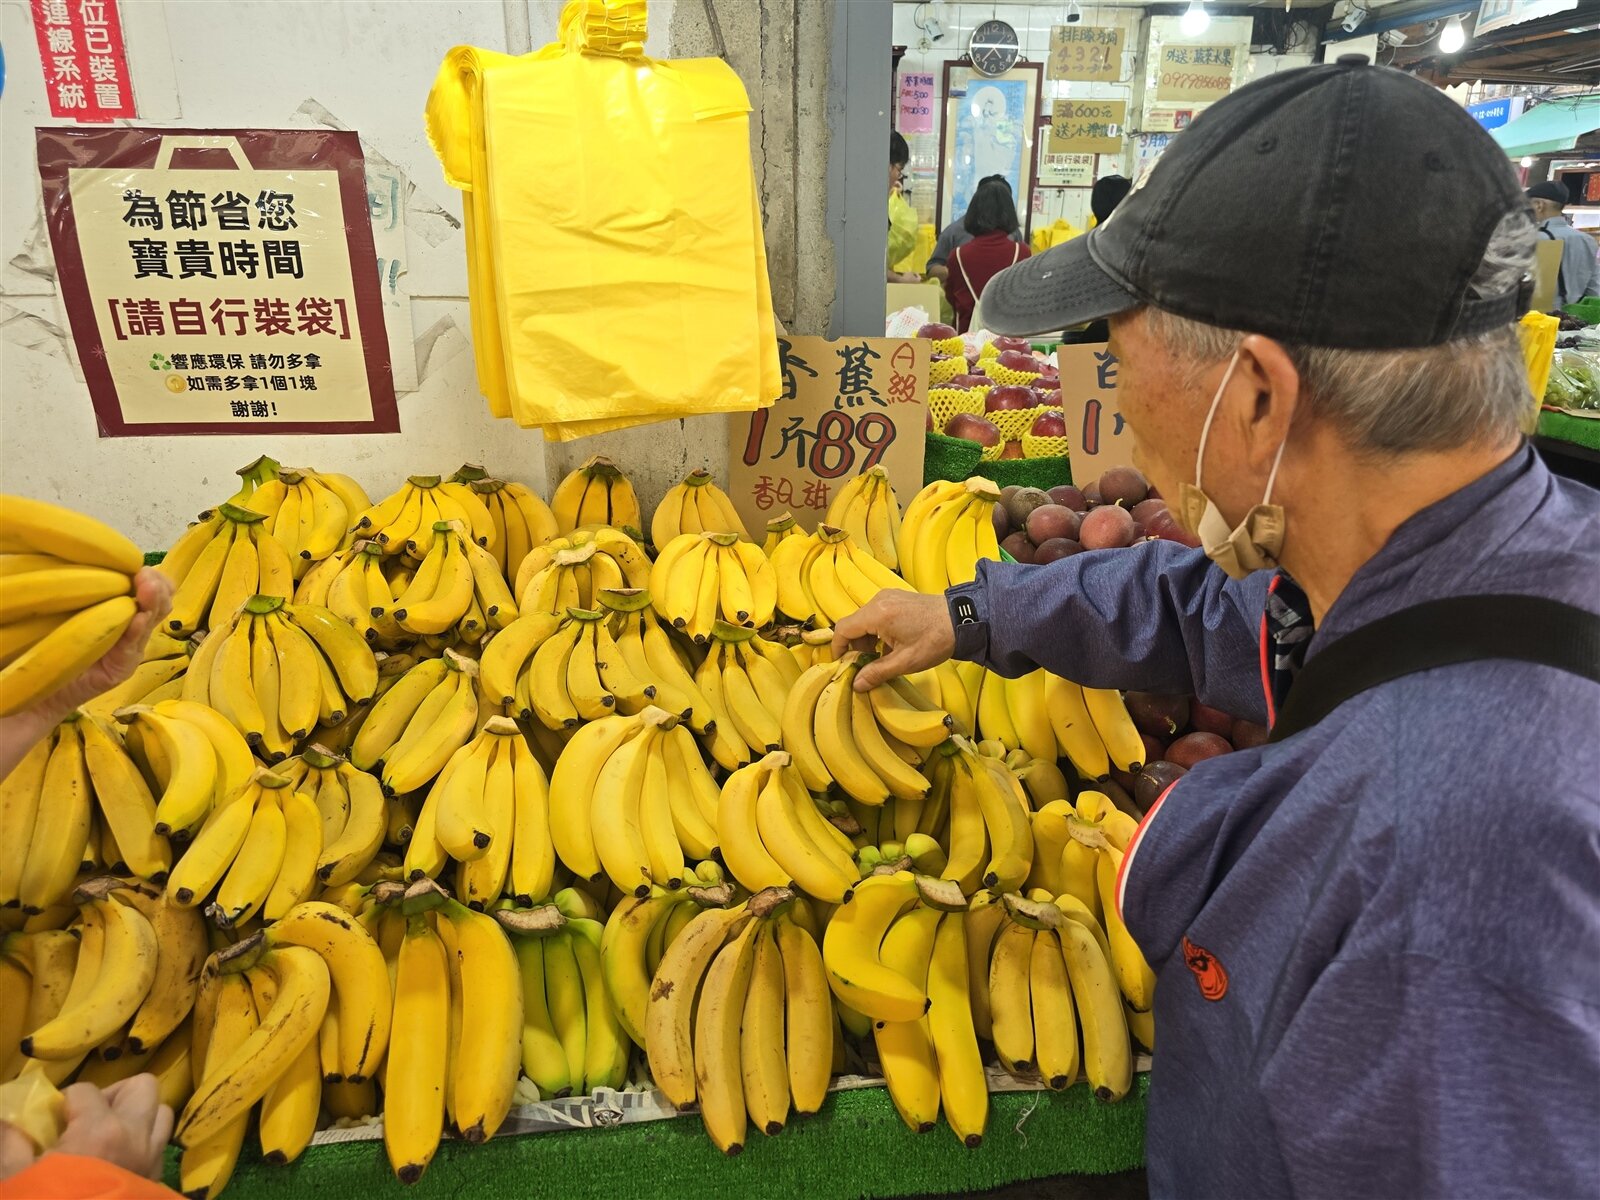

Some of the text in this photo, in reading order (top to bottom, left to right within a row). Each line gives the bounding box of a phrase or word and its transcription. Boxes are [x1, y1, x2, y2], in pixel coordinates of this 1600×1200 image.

[122, 189, 299, 232] 為節省您
[128, 238, 304, 280] 寶貴時間
[108, 298, 351, 340] [請自行裝袋]
[170, 353, 322, 370] 響應環保 請勿多拿
[186, 375, 318, 391] 如需多拿1個1塊
[229, 400, 278, 418] 謝謝!
